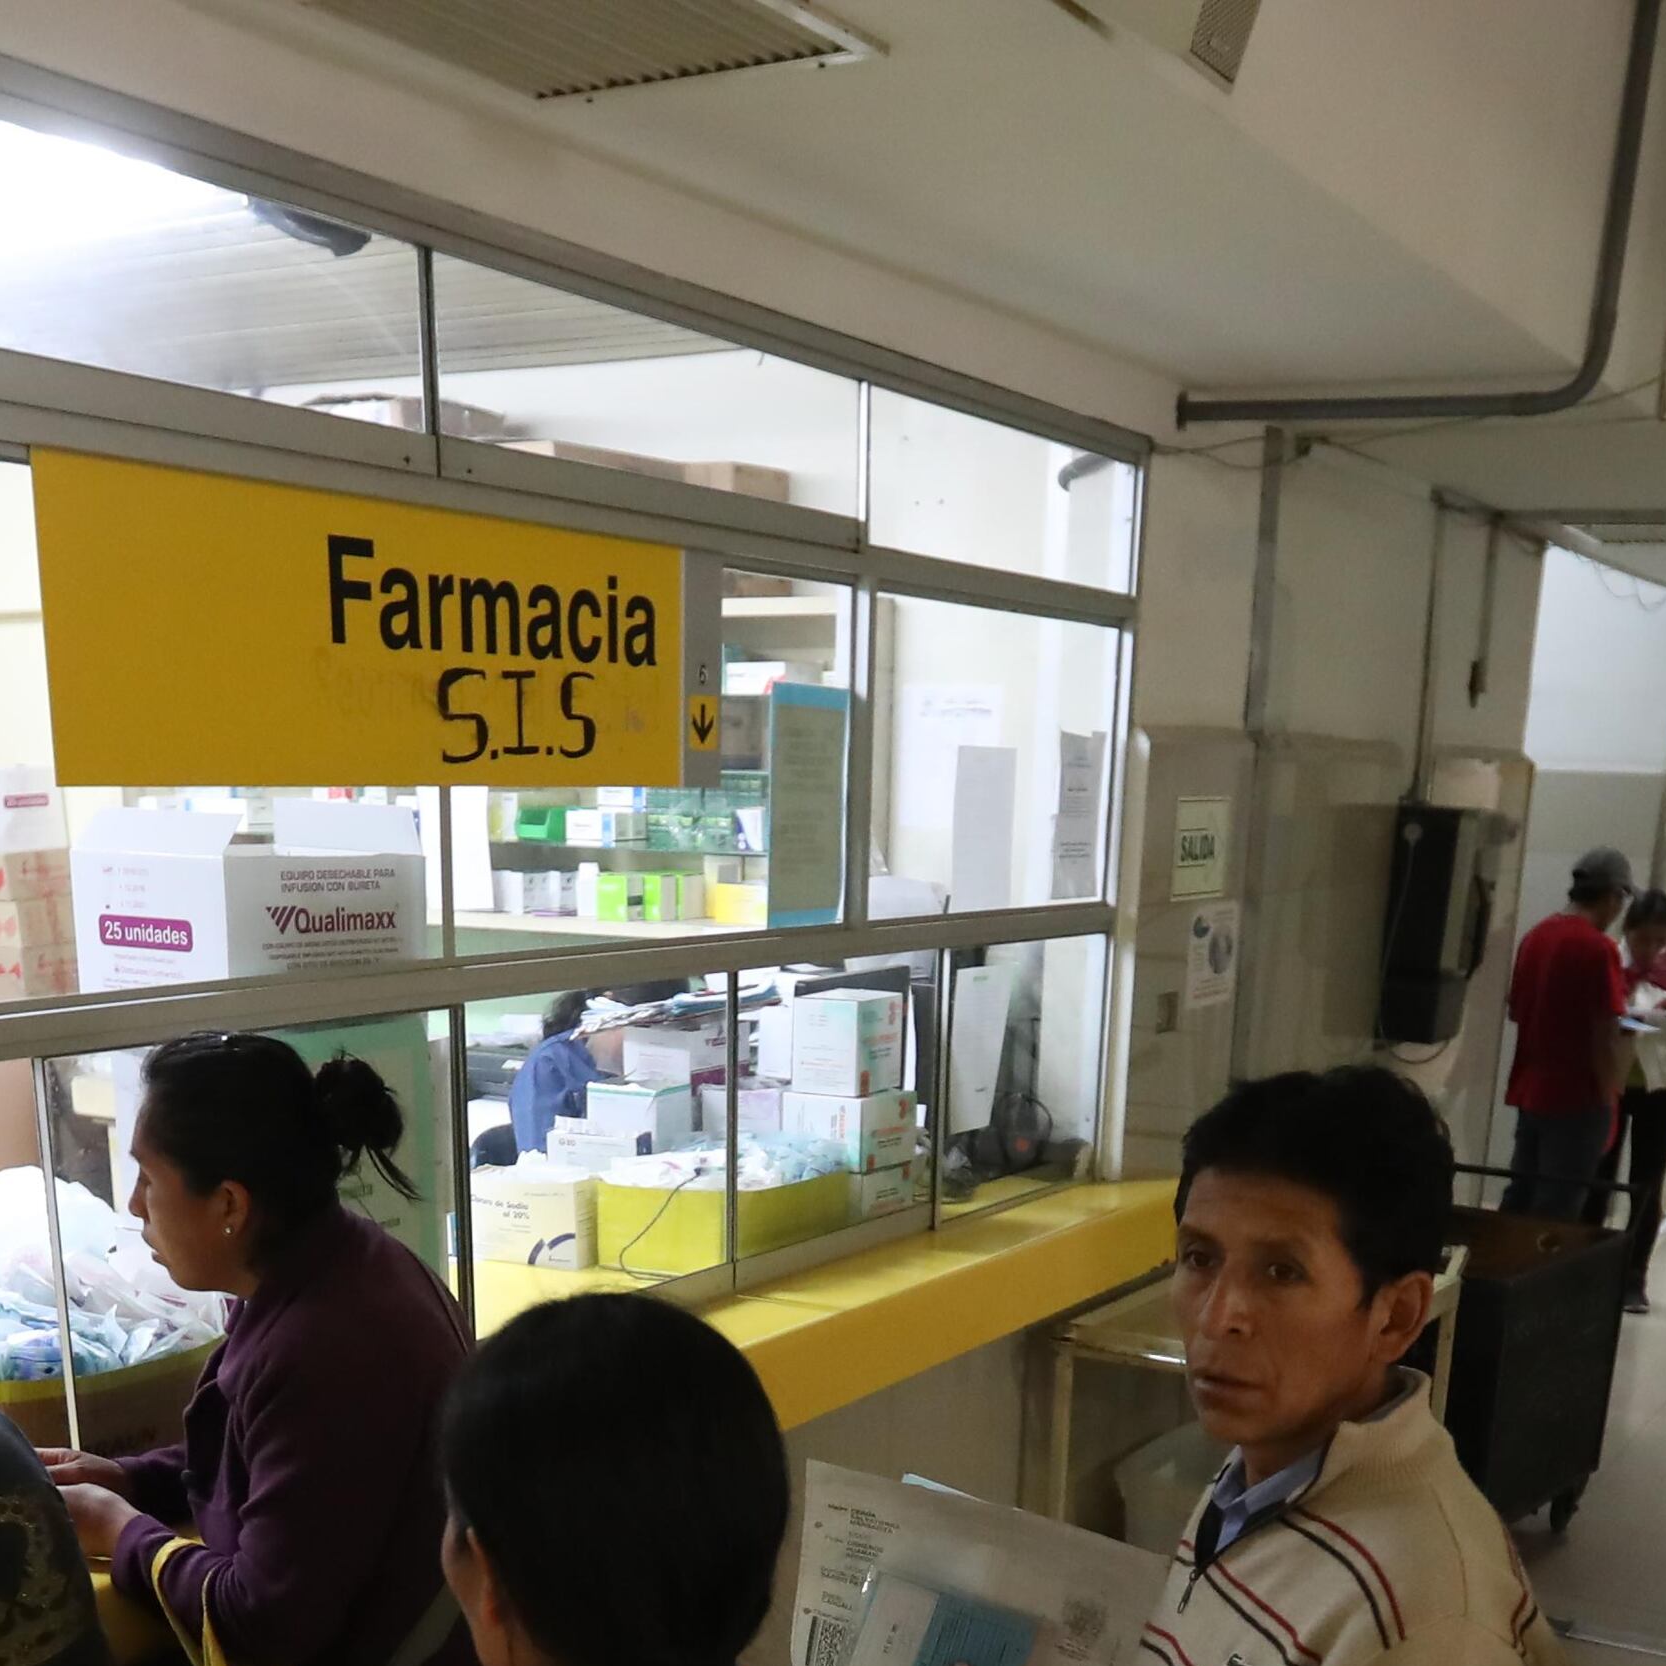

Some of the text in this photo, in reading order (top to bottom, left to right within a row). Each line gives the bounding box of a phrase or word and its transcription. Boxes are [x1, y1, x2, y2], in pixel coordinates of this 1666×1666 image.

[327, 534, 657, 667] Farmacia
[698, 664, 708, 685] 6
[436, 666, 597, 764] S.I.S
[1180, 834, 1215, 862] SALIDA
[281, 868, 395, 881] EQUIPO DESECHABLE PARA
[282, 879, 381, 892] INFUSION CON BURETA
[105, 920, 188, 945] 25 unidades
[295, 906, 396, 934] Qualimaxx
